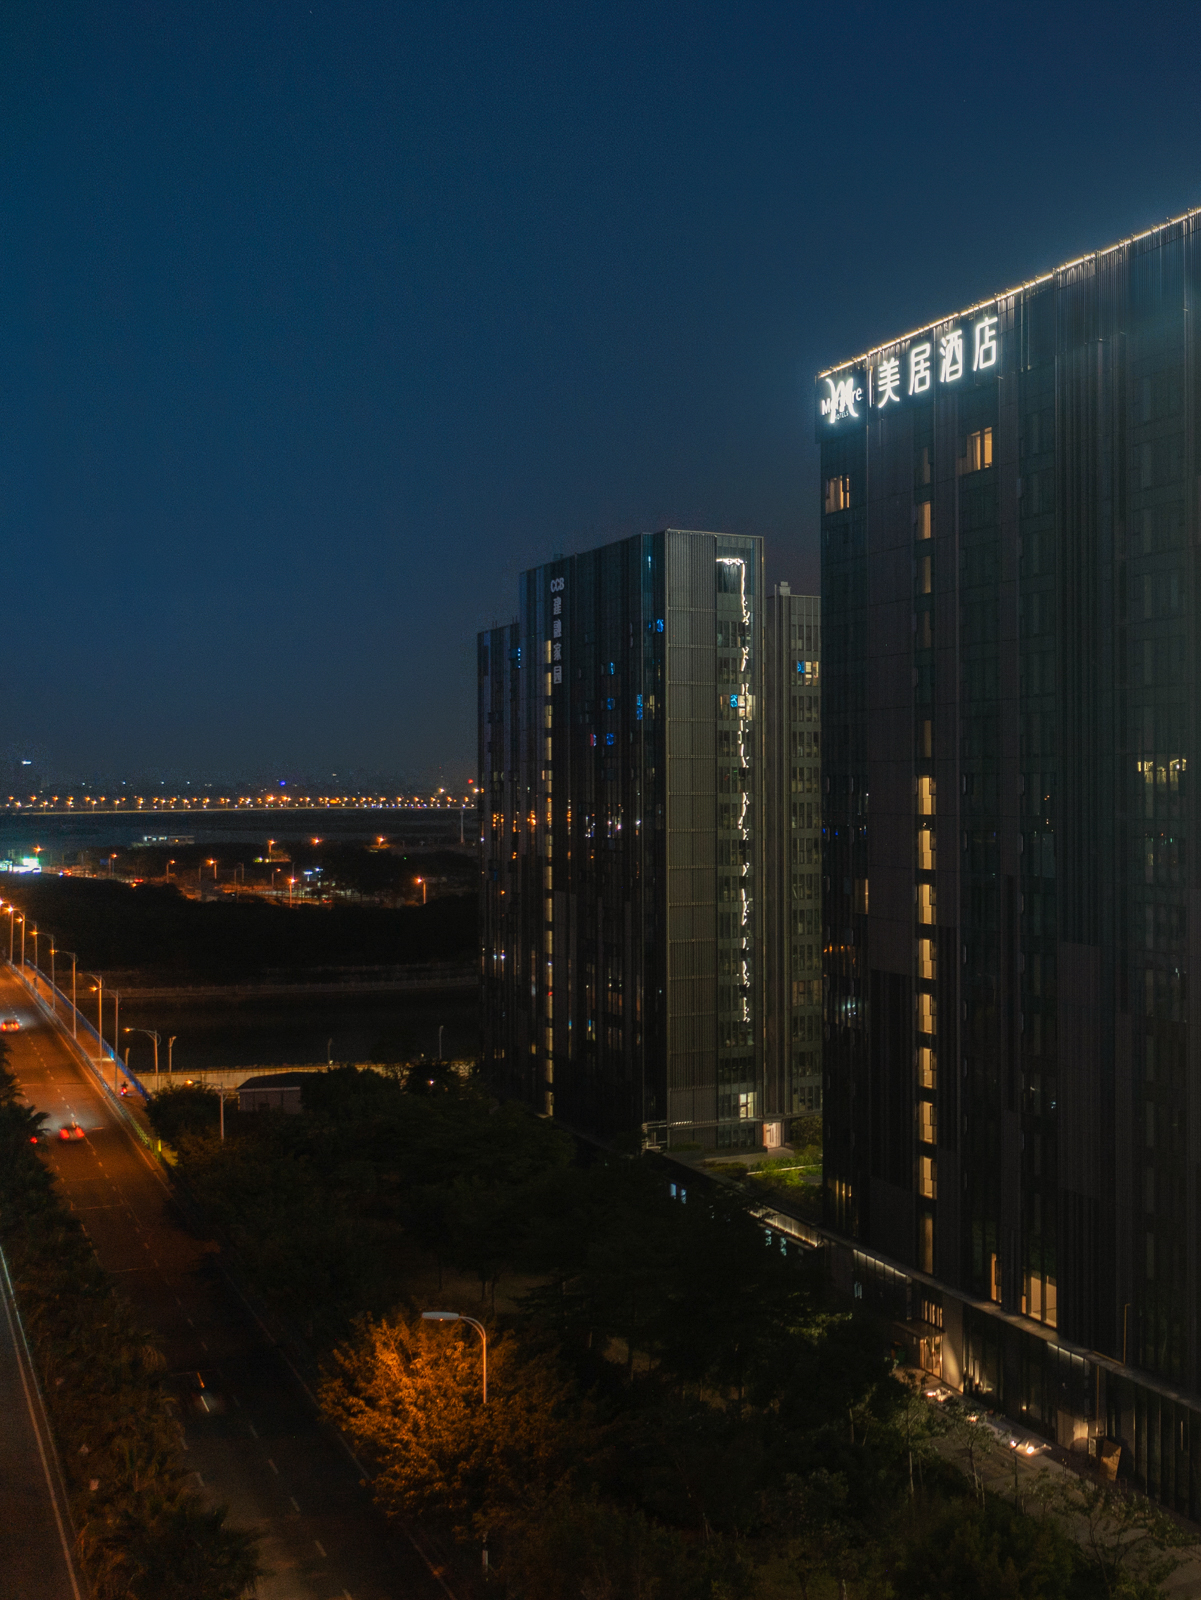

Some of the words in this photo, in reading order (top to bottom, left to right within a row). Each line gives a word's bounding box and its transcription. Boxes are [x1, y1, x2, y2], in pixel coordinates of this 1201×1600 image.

[877, 316, 999, 409] 美居酒店
[550, 577, 565, 593] CCB
